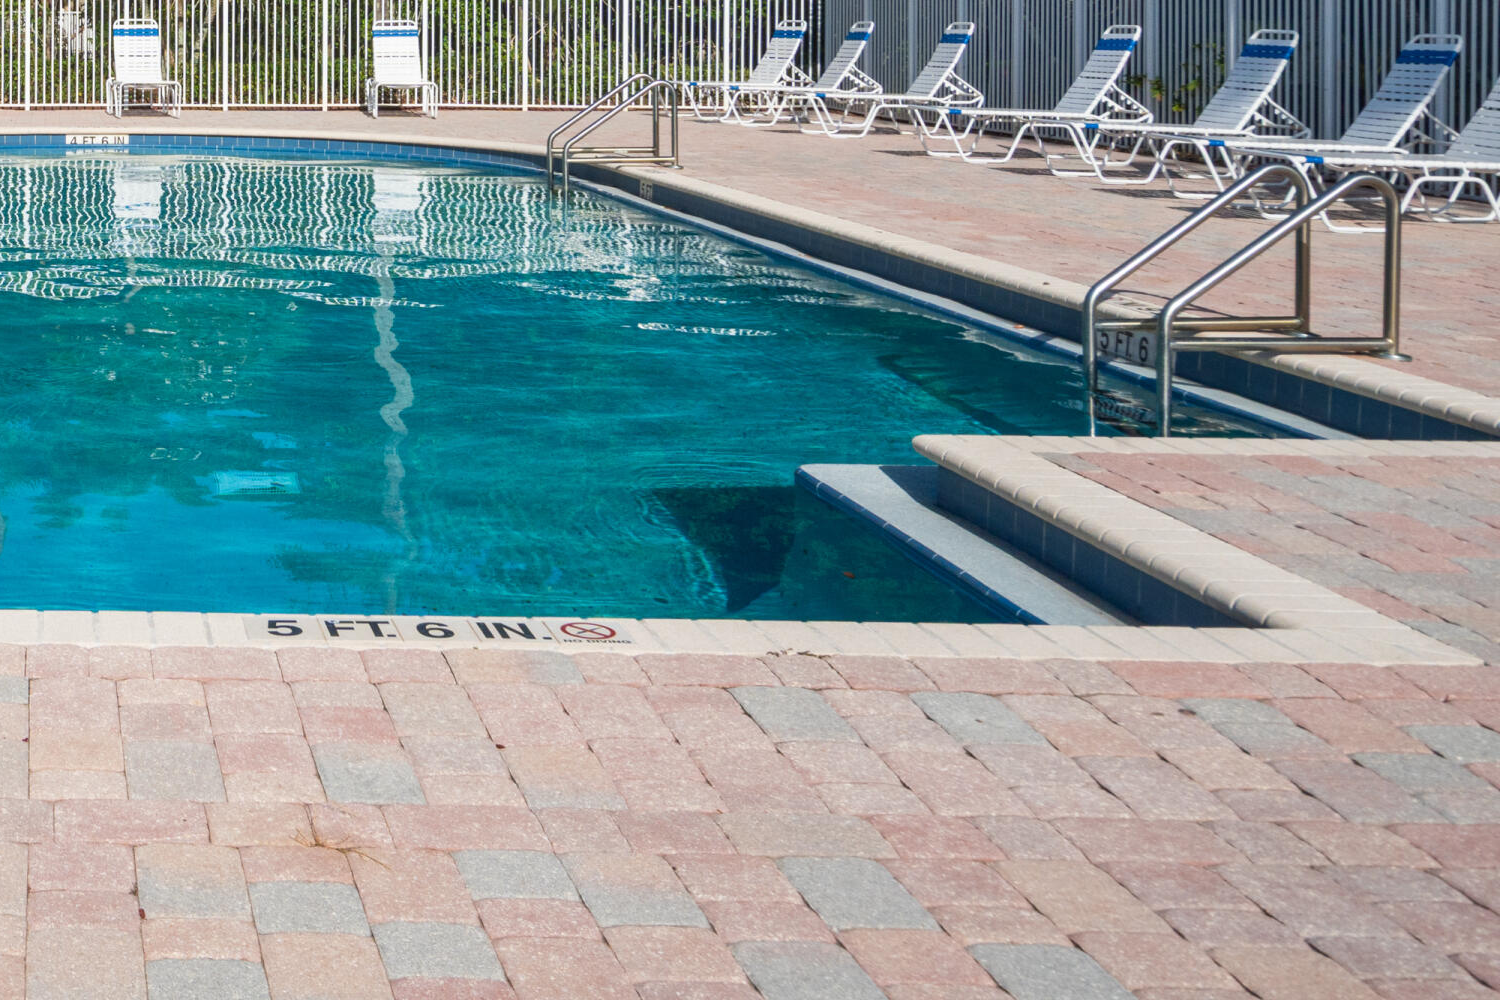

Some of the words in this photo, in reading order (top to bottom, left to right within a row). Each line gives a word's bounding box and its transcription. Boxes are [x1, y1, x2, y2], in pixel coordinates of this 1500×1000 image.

[70, 136, 78, 145] 4
[101, 136, 109, 145] 6
[1139, 336, 1149, 362] 6
[267, 620, 303, 636] 5
[324, 620, 397, 637] FT.
[416, 622, 455, 639] 6
[476, 622, 552, 640] IN.
